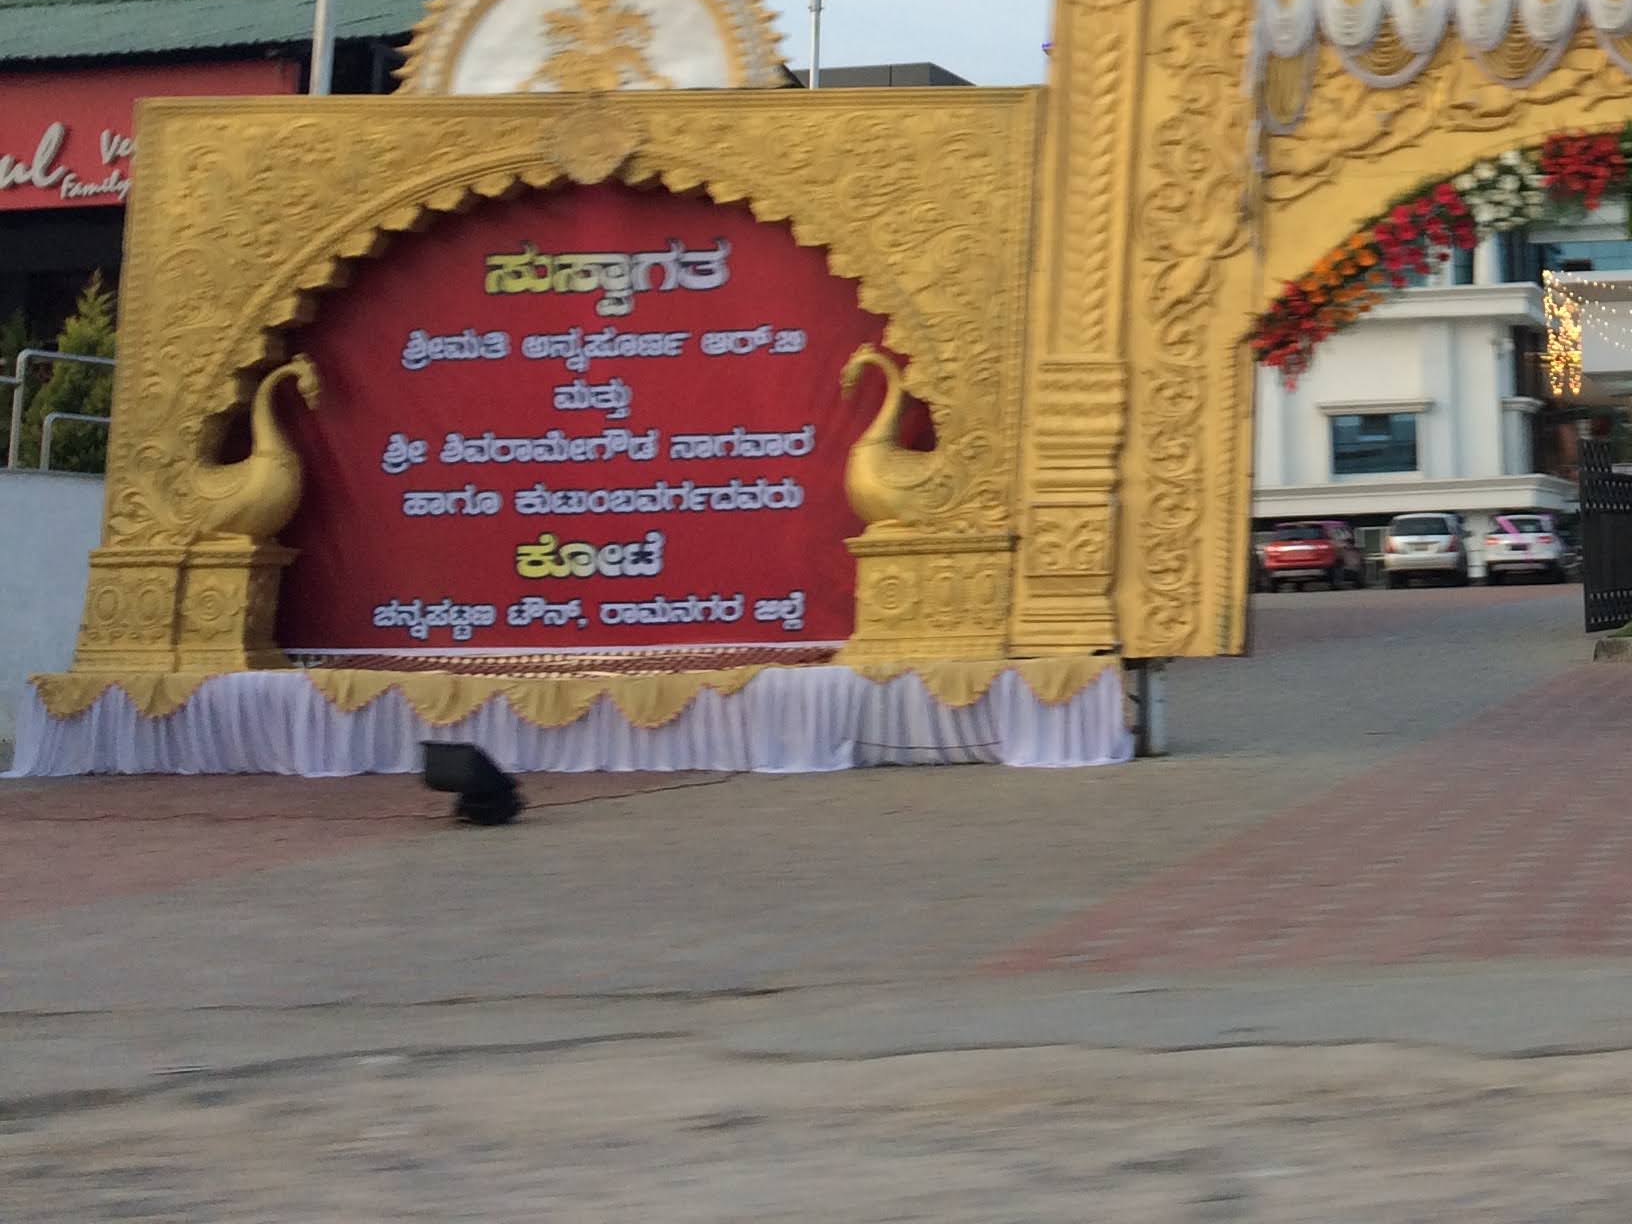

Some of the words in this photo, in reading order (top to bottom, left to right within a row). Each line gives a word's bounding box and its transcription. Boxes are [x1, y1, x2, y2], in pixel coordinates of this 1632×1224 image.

[484, 242, 731, 317] ಸುಸ್ವಾಗತ
[400, 328, 510, 371] ಶ್ರೀಮತಿ
[553, 377, 633, 420] ಮತ್ತು
[381, 433, 428, 475] ಶ್ರೀ
[402, 483, 503, 516] ಹಾಗೂ
[598, 593, 745, 625] ರಾಮನಗರ
